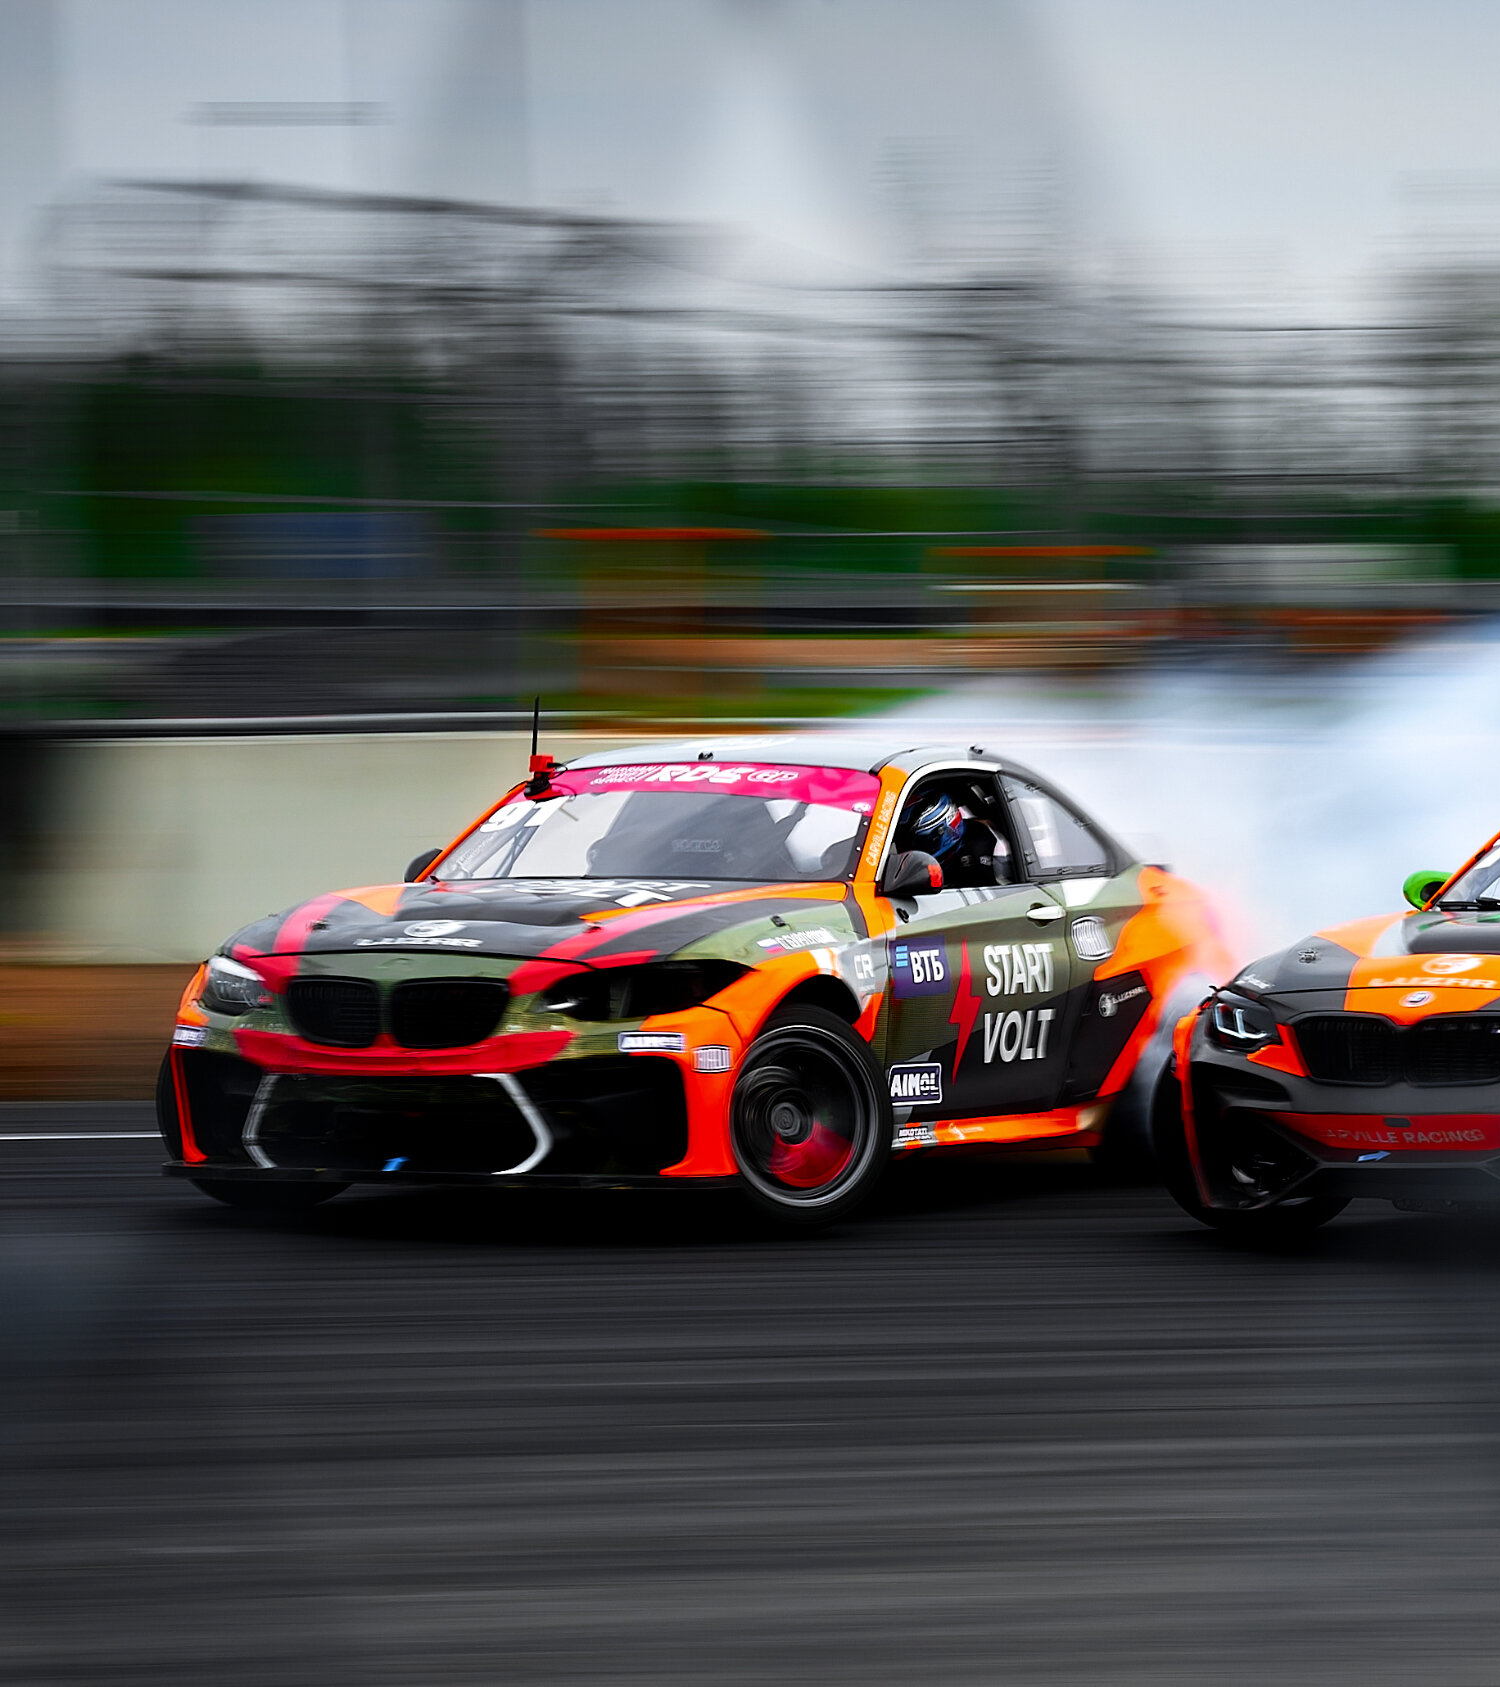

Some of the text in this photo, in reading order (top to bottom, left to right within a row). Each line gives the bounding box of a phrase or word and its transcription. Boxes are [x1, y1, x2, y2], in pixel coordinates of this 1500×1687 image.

[645, 765, 756, 784] RDS
[480, 795, 570, 833] 91
[854, 953, 875, 980] CR
[910, 949, 945, 984] ВТБ
[984, 943, 1054, 997] START
[1368, 976, 1498, 989] LUZAR
[984, 1008, 1057, 1064] VOLT
[890, 1072, 940, 1098] AIMOL
